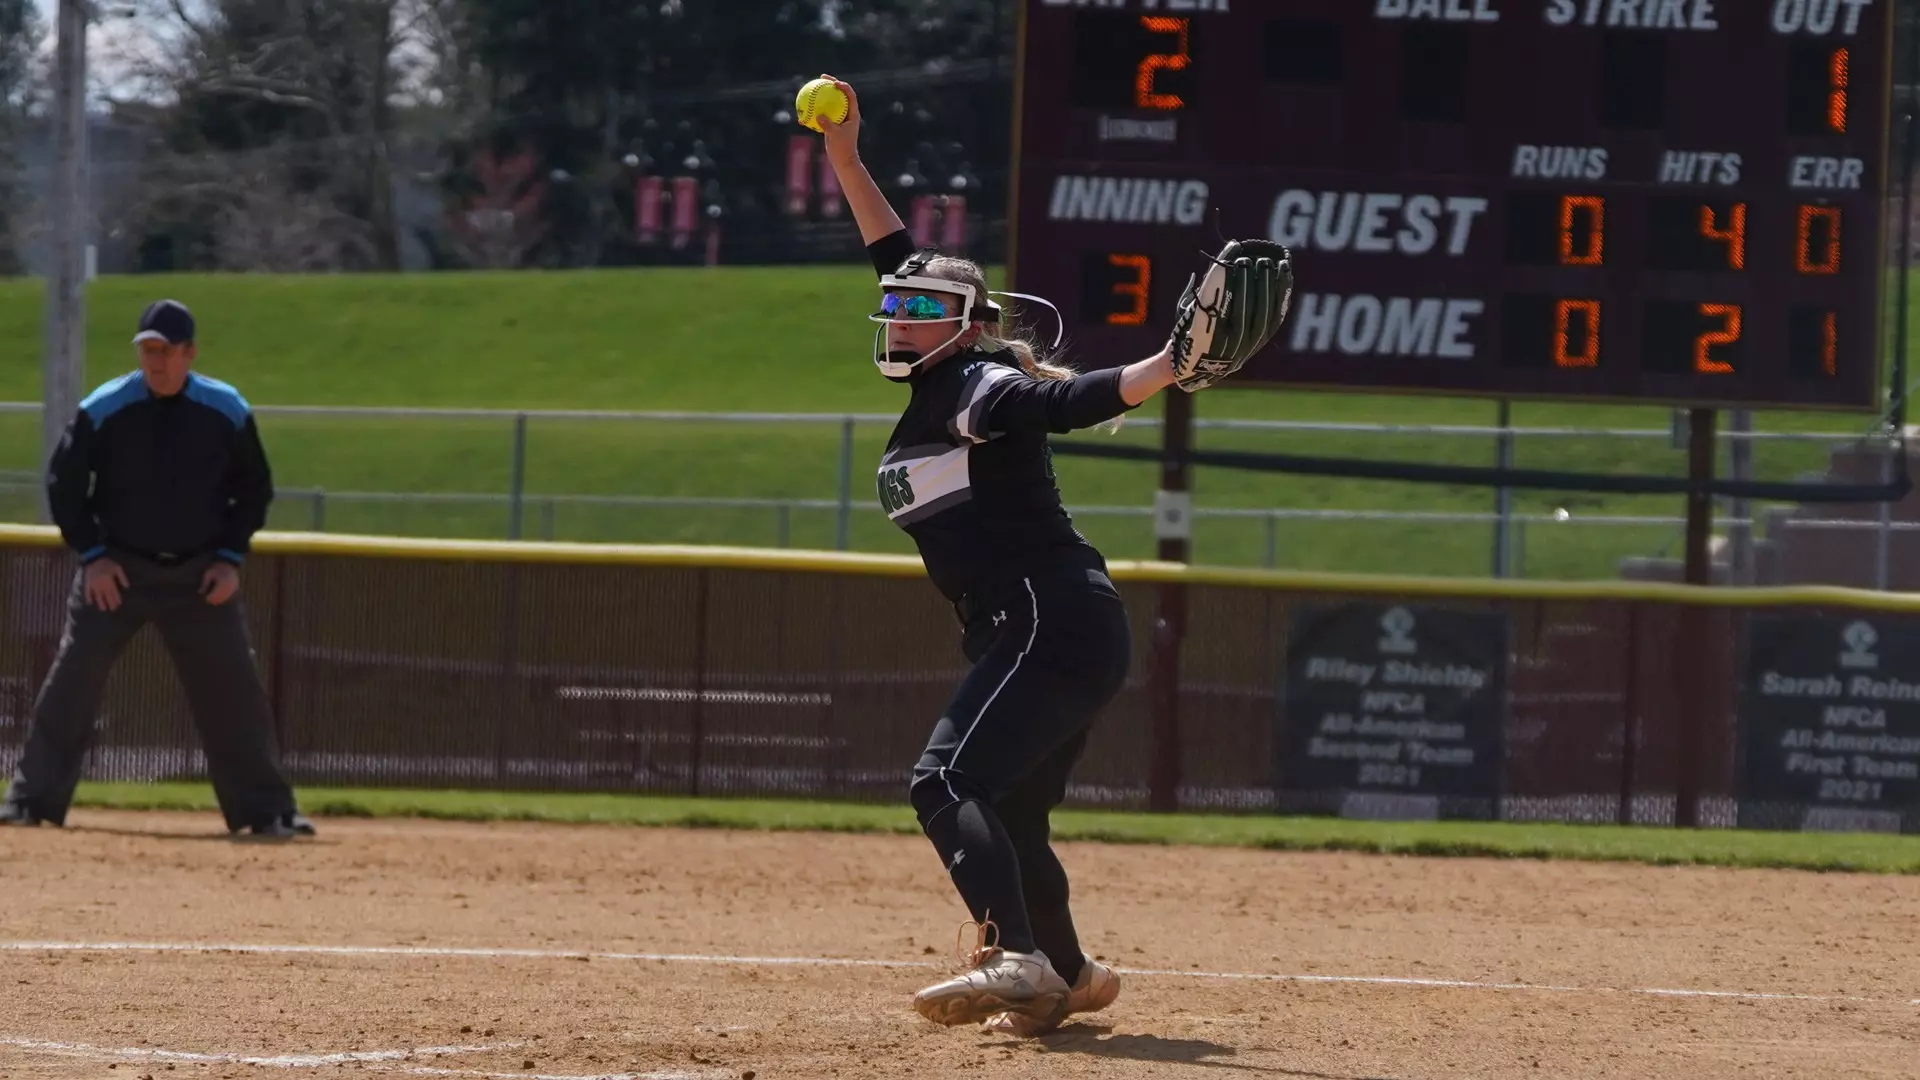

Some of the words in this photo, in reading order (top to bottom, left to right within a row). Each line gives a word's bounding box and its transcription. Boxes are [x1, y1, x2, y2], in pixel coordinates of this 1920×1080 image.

[1546, 0, 1718, 30] STRIKE
[1772, 0, 1872, 35] OUT
[1136, 15, 1190, 110] 2
[1828, 47, 1849, 133] 1
[1512, 145, 1608, 180] RUNS
[1657, 150, 1743, 185] HITS
[1789, 156, 1864, 189] ERR
[1050, 176, 1208, 223] INNING
[1268, 189, 1488, 255] GUEST
[1560, 195, 1605, 265] 0
[1699, 202, 1746, 270] 4
[1795, 204, 1841, 274] 0
[1106, 254, 1151, 325] 3
[1291, 293, 1483, 358] HOME
[1554, 300, 1601, 367] 0
[1694, 302, 1742, 373] 2
[1822, 311, 1837, 376] 1
[1307, 657, 1375, 685] Riley
[1761, 671, 1844, 696] Sarah
[1362, 692, 1426, 714] NFCA
[1823, 706, 1888, 729] NFCA
[1321, 714, 1465, 738] All-American
[1308, 736, 1402, 761] Second
[1407, 741, 1475, 765] Team
[1785, 752, 1848, 776] First
[1854, 756, 1918, 778] Team
[1357, 763, 1422, 787] 2021
[1818, 777, 1884, 800] 2021
